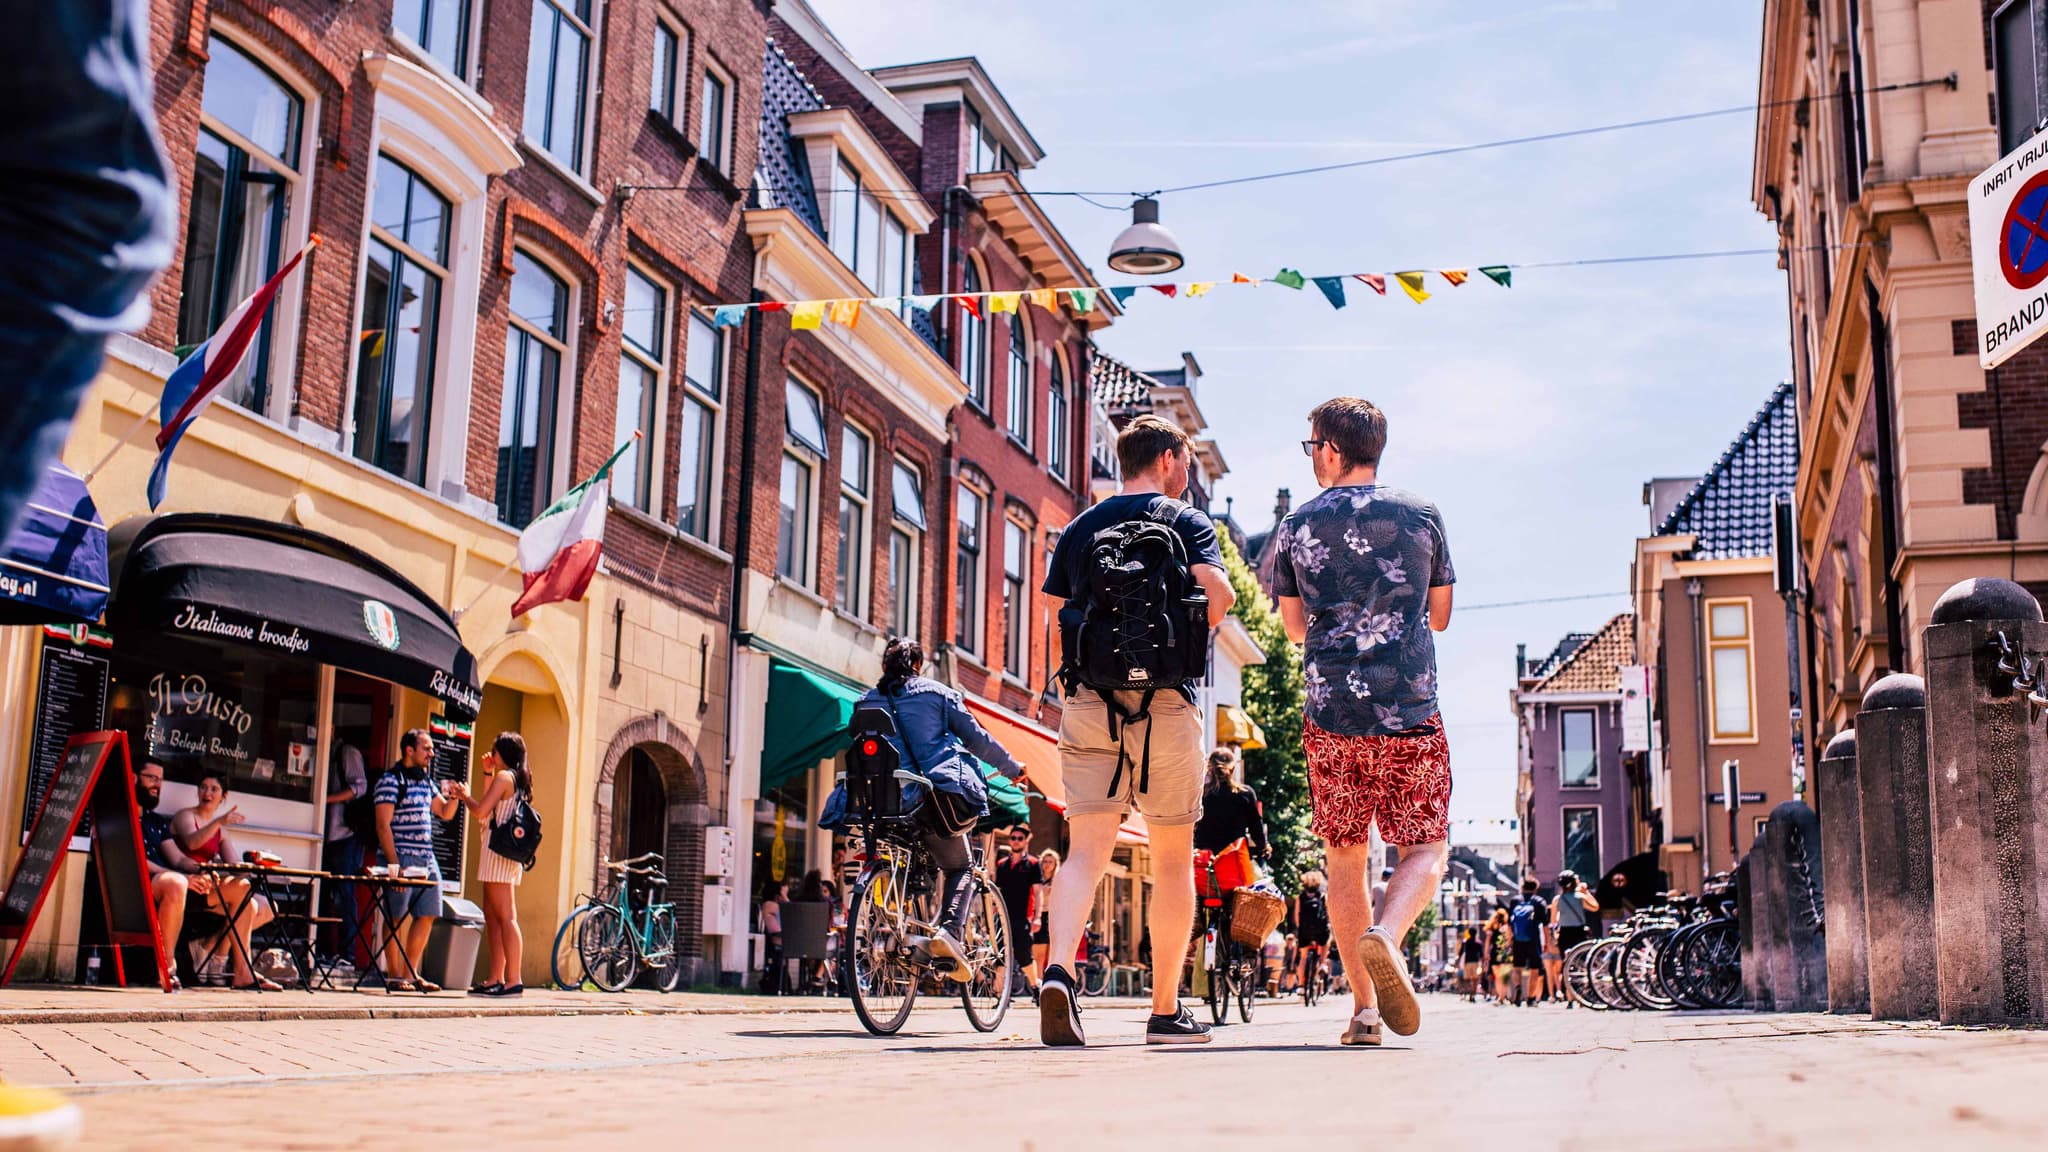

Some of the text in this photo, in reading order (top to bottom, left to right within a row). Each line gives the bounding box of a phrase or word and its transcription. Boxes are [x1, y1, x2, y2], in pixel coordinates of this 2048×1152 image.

[1983, 164, 2014, 198] INRIT
[1986, 292, 2048, 354] BRAND
[0, 572, 37, 597] ay.nl
[174, 605, 309, 653] Italiaanse broodjes
[181, 674, 252, 735] Gusto
[169, 729, 207, 753] Belegde
